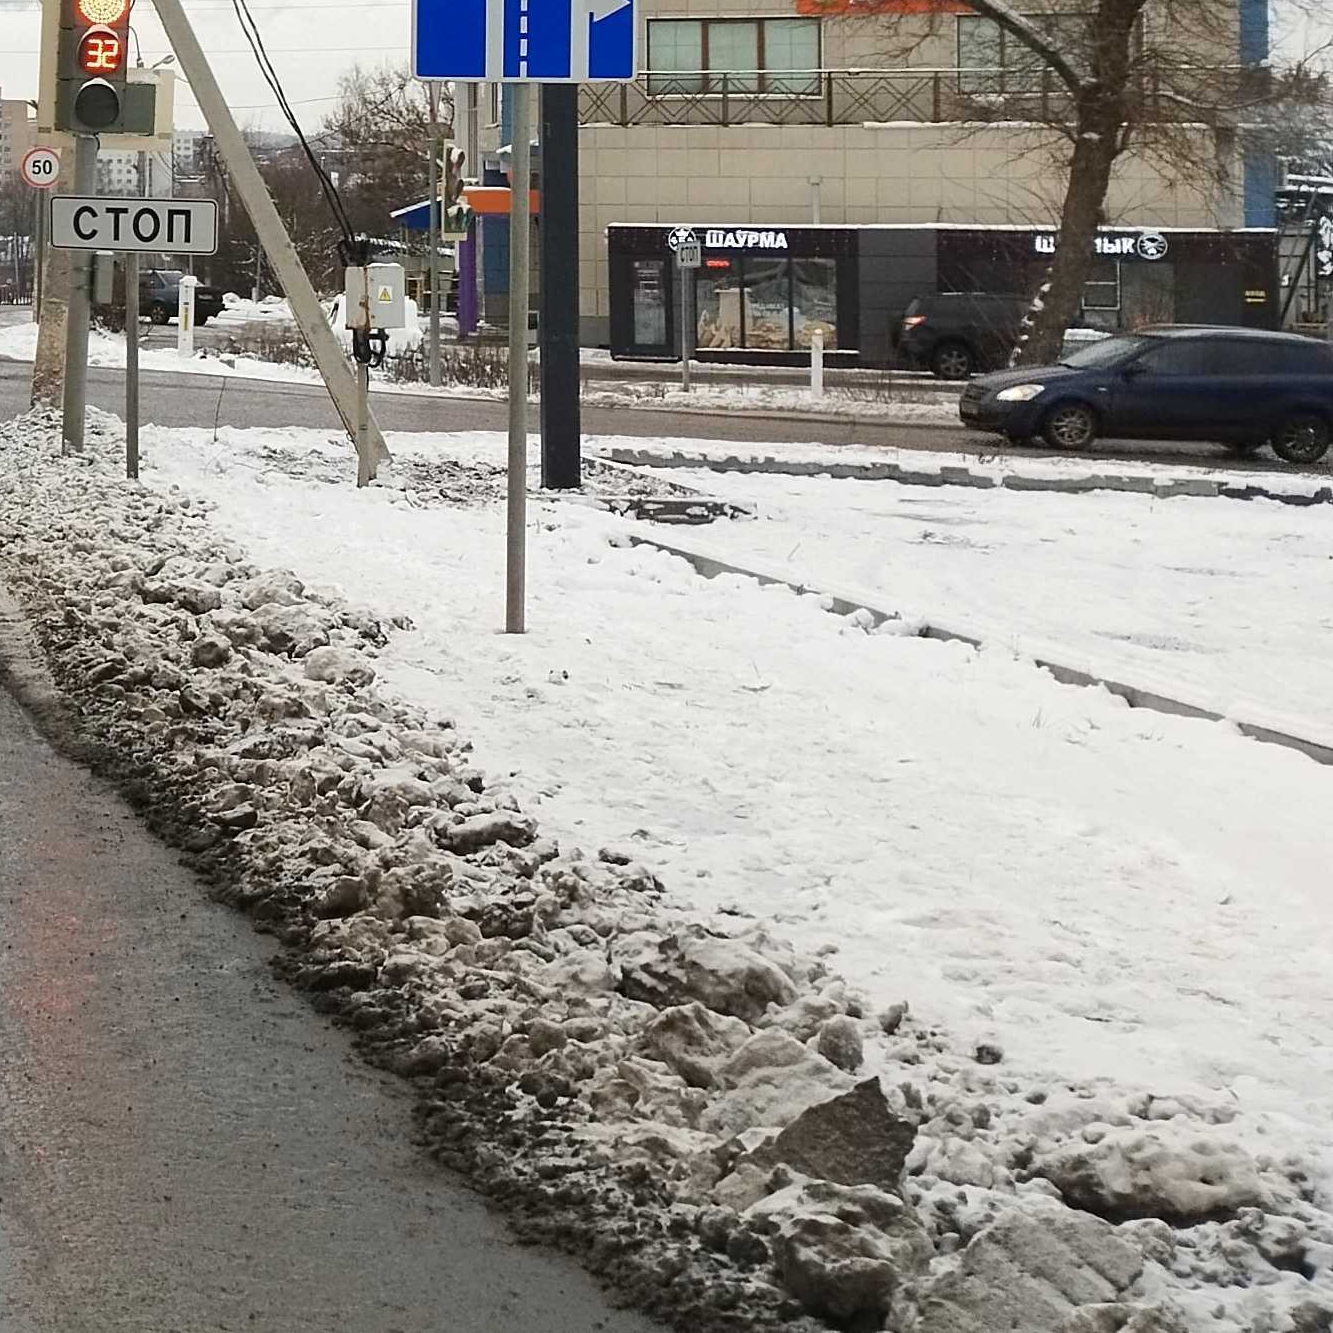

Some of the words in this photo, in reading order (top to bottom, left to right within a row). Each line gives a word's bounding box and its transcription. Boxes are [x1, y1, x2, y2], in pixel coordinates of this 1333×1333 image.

[86, 39, 118, 69] 32
[32, 160, 53, 175] 50
[73, 205, 192, 244] СТОП
[705, 230, 788, 249] ШАУРМА
